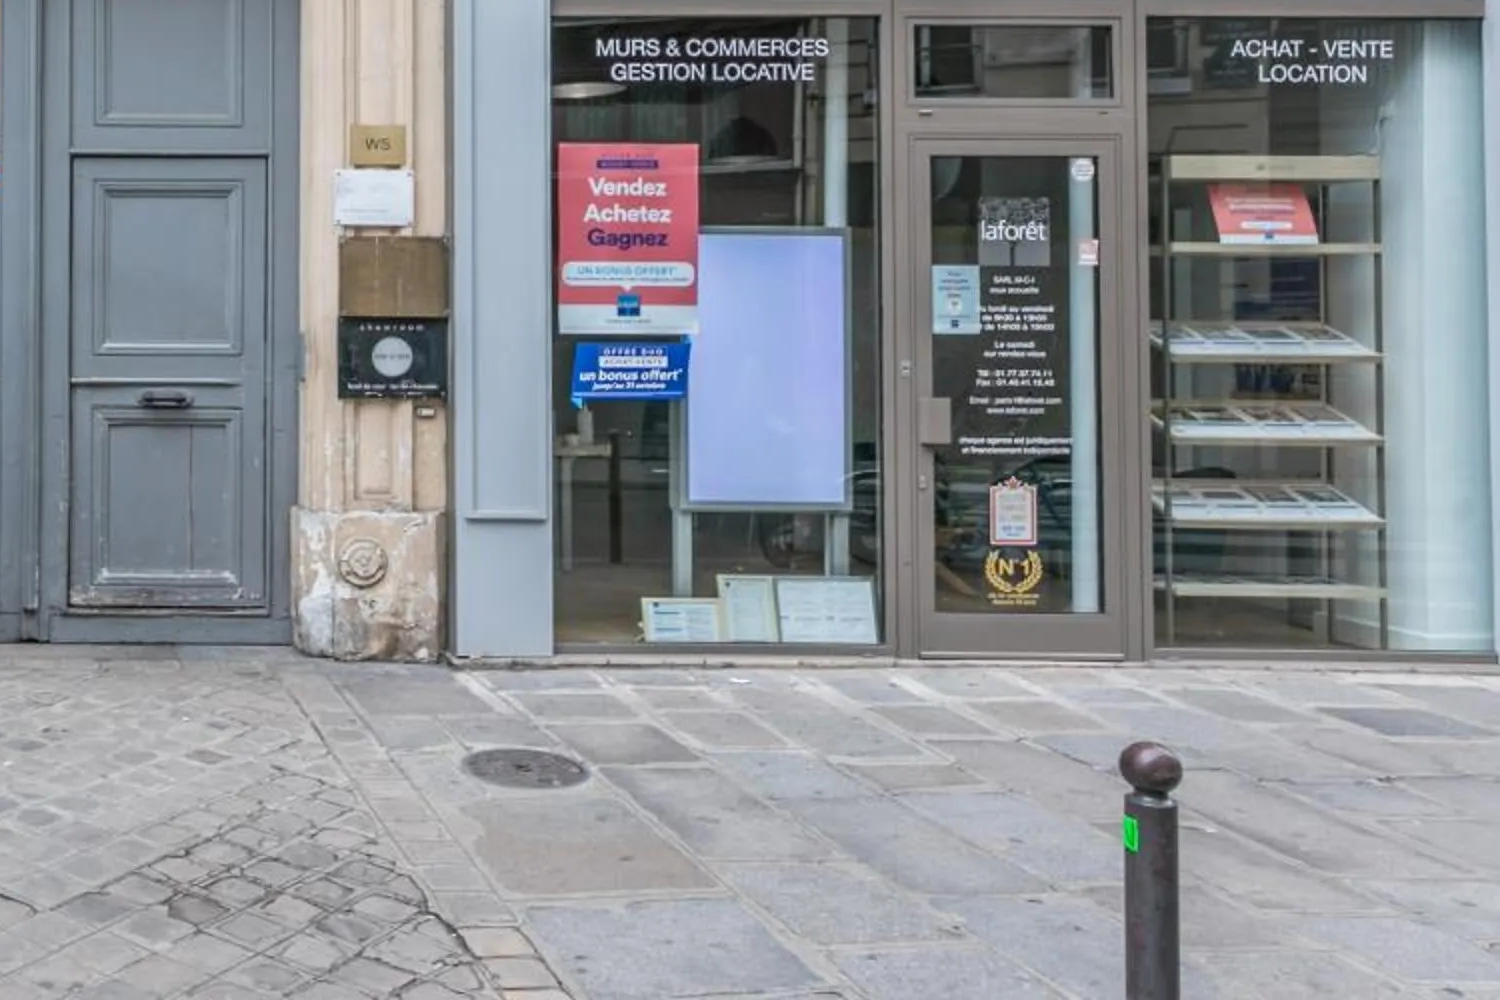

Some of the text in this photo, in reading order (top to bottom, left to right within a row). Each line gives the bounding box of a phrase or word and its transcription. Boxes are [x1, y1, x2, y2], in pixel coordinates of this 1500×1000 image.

[595, 38, 829, 57] MURS & COMMERCES
[1230, 40, 1304, 59] ACHAT
[1323, 40, 1395, 58] VENTE
[610, 63, 815, 82] GESTION LOCATIVE
[1259, 65, 1367, 83] LOCATION
[588, 177, 668, 197] Vendez
[583, 203, 673, 223] Achetez
[587, 228, 669, 250] Gagnez
[981, 219, 1047, 241] laforêt
[579, 371, 596, 382] un
[598, 369, 639, 381] bonus
